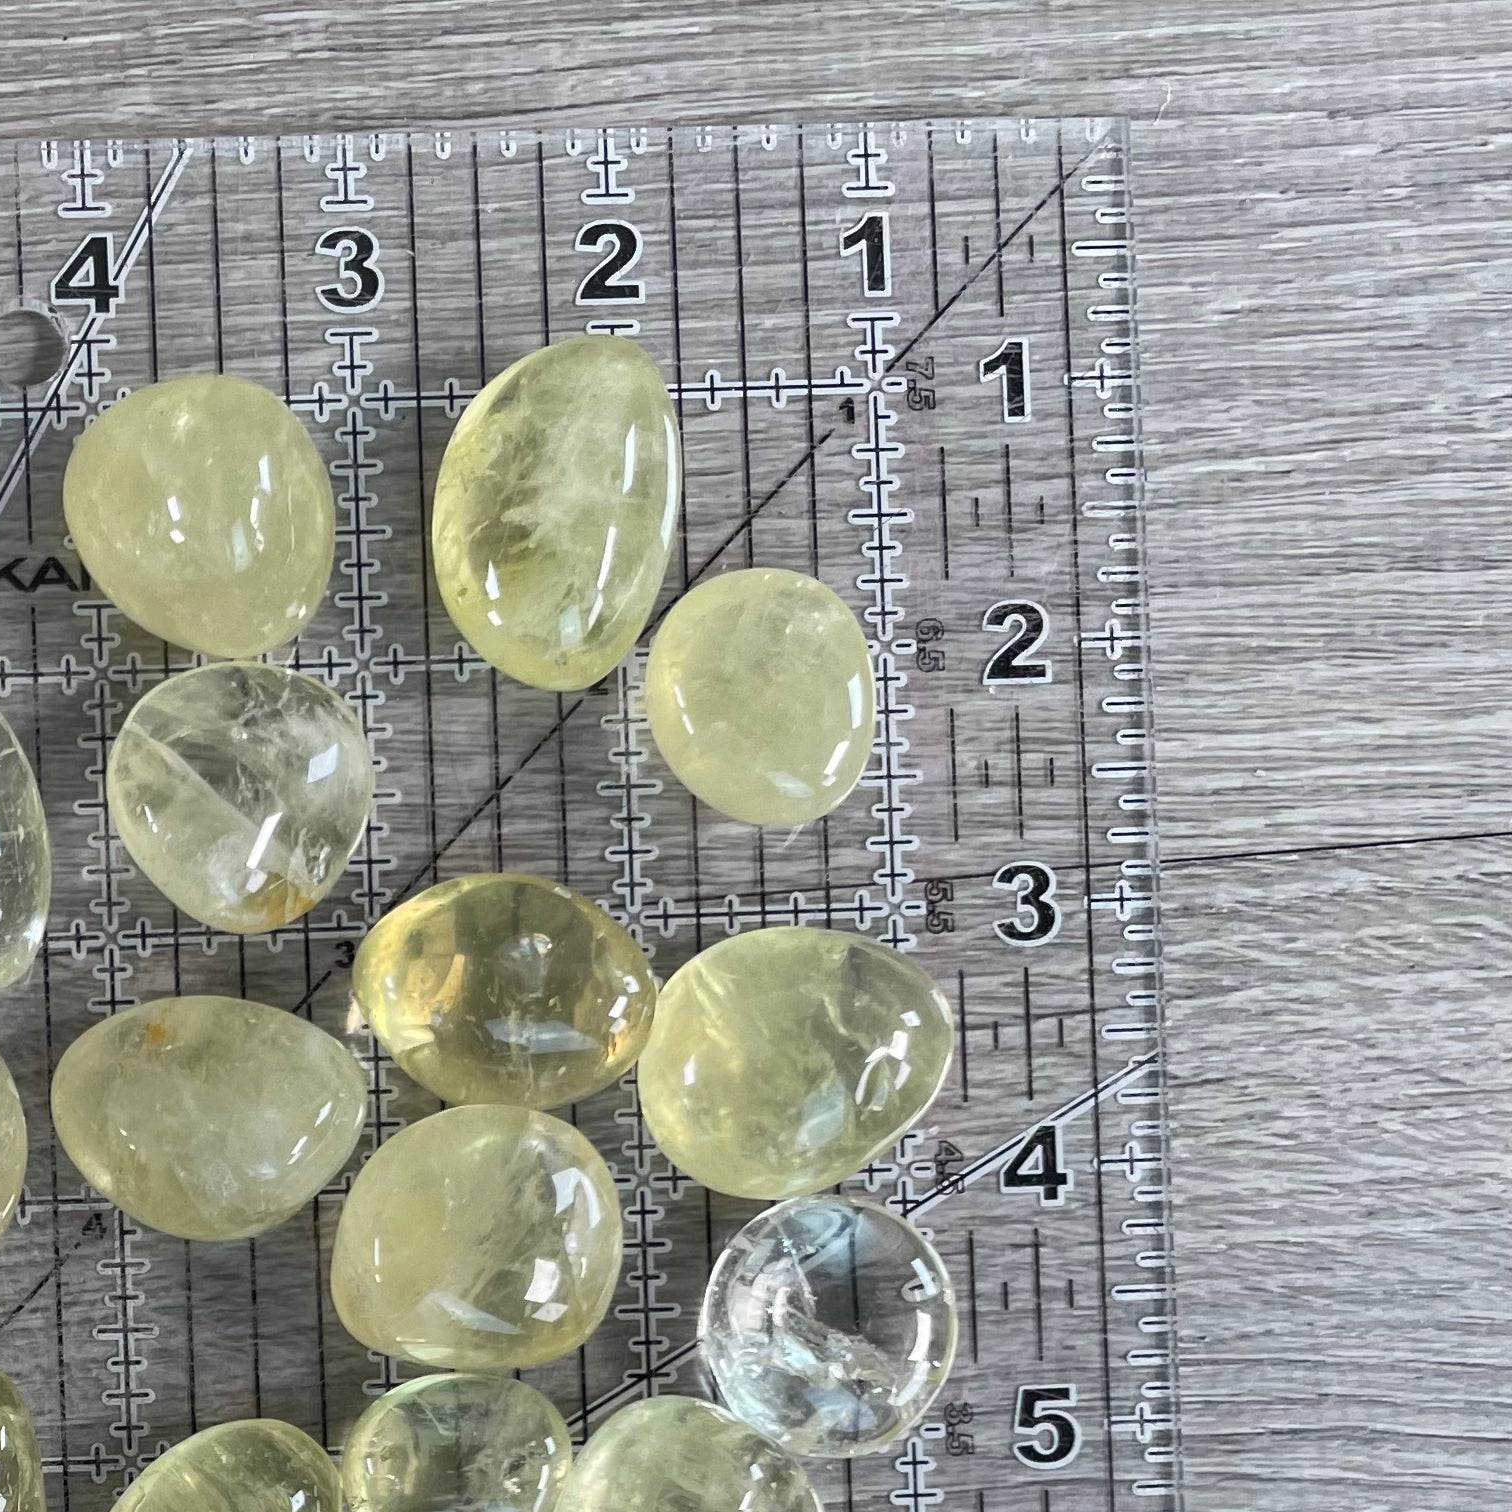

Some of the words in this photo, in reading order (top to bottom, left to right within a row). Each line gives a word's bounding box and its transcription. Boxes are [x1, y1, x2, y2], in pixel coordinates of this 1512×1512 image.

[52, 233, 125, 317] 4
[315, 226, 384, 313] 3
[575, 220, 645, 305] 2
[840, 212, 892, 297] 1
[839, 397, 855, 424] 1
[979, 338, 1031, 424] 1
[983, 600, 1052, 686] 2
[992, 861, 1062, 947] 3
[334, 940, 355, 968] 3
[1000, 1121, 1074, 1207] 4
[82, 1213, 106, 1239] 4
[1013, 1383, 1082, 1470] 5
